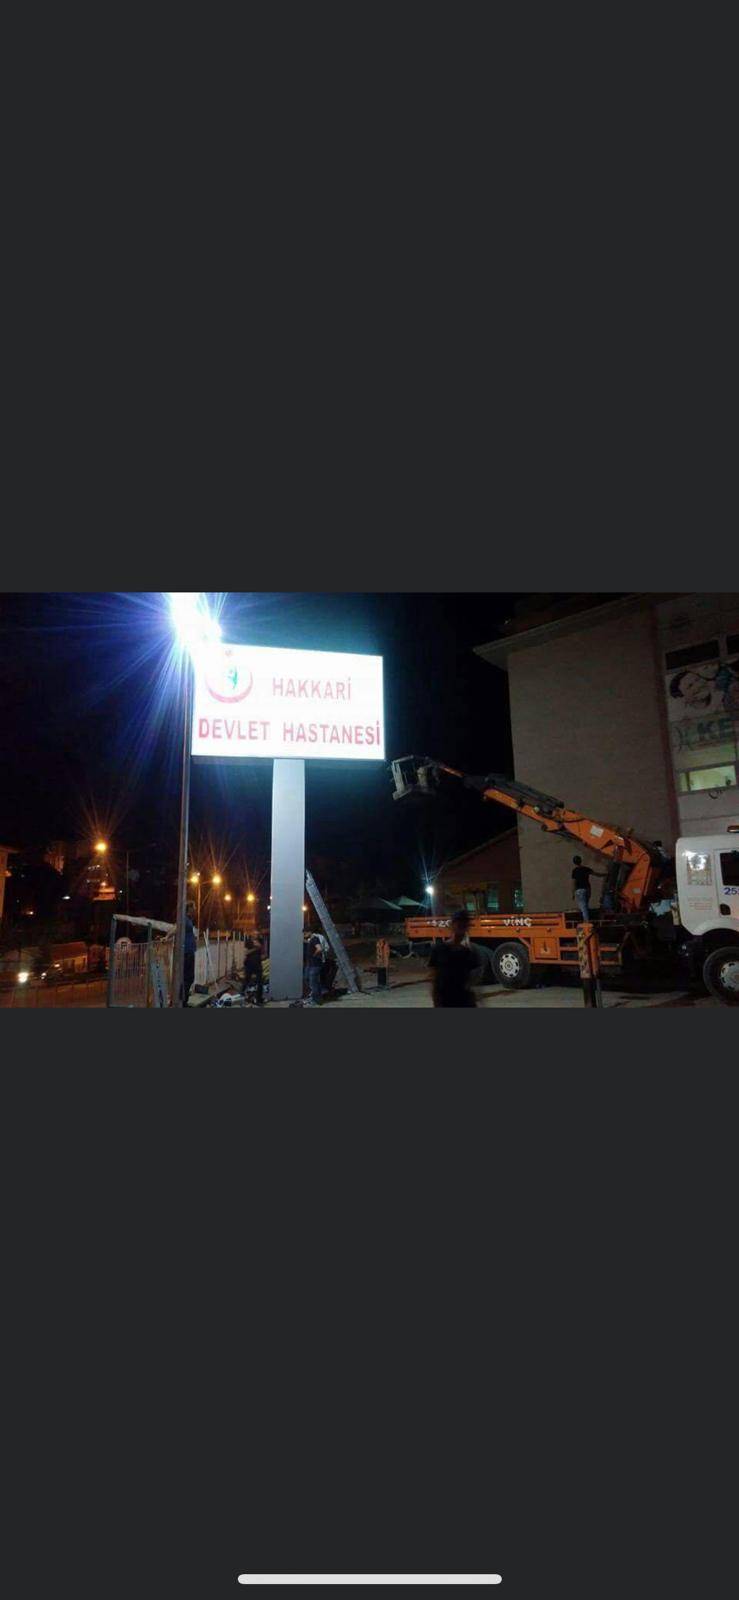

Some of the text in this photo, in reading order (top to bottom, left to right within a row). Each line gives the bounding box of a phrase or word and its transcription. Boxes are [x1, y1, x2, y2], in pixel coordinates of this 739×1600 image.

[273, 677, 352, 700] HAKKARİ
[198, 718, 381, 745] DEVLET HASTANESİ
